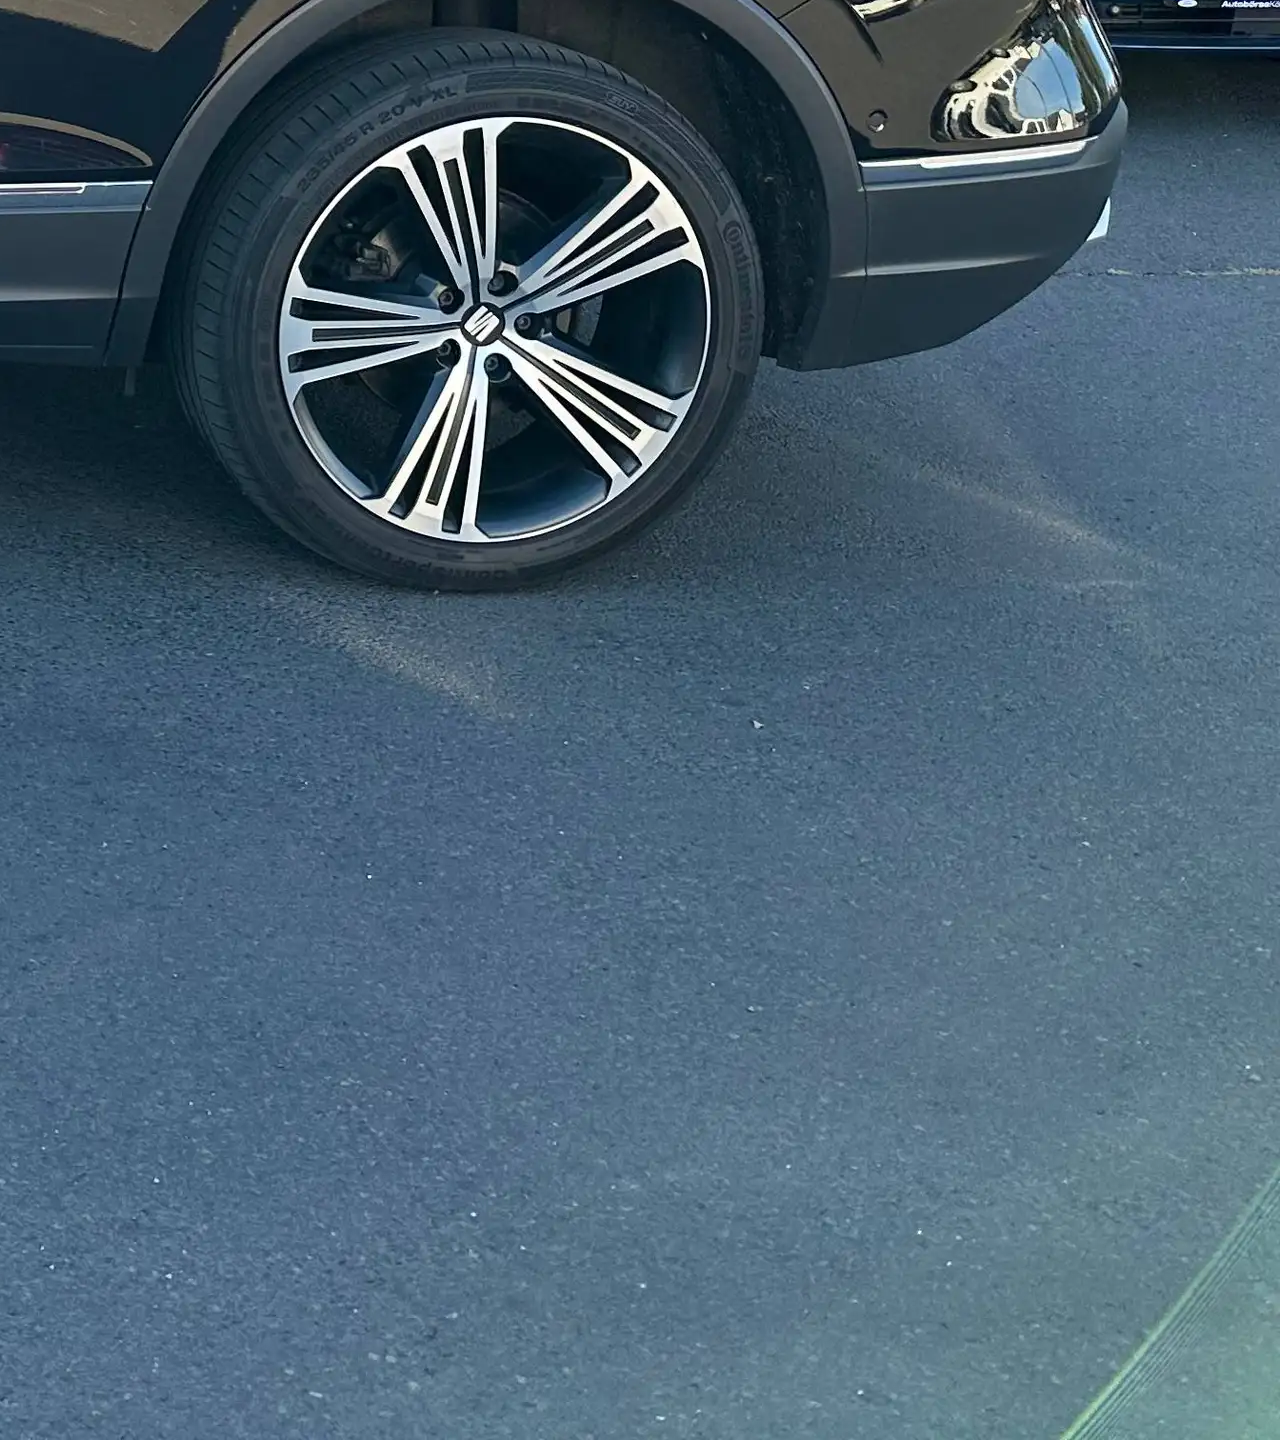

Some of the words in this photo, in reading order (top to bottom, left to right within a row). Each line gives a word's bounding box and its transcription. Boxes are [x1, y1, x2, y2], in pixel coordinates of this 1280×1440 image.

[297, 132, 358, 193] 235/45
[358, 121, 376, 136] R
[377, 104, 405, 126] 20
